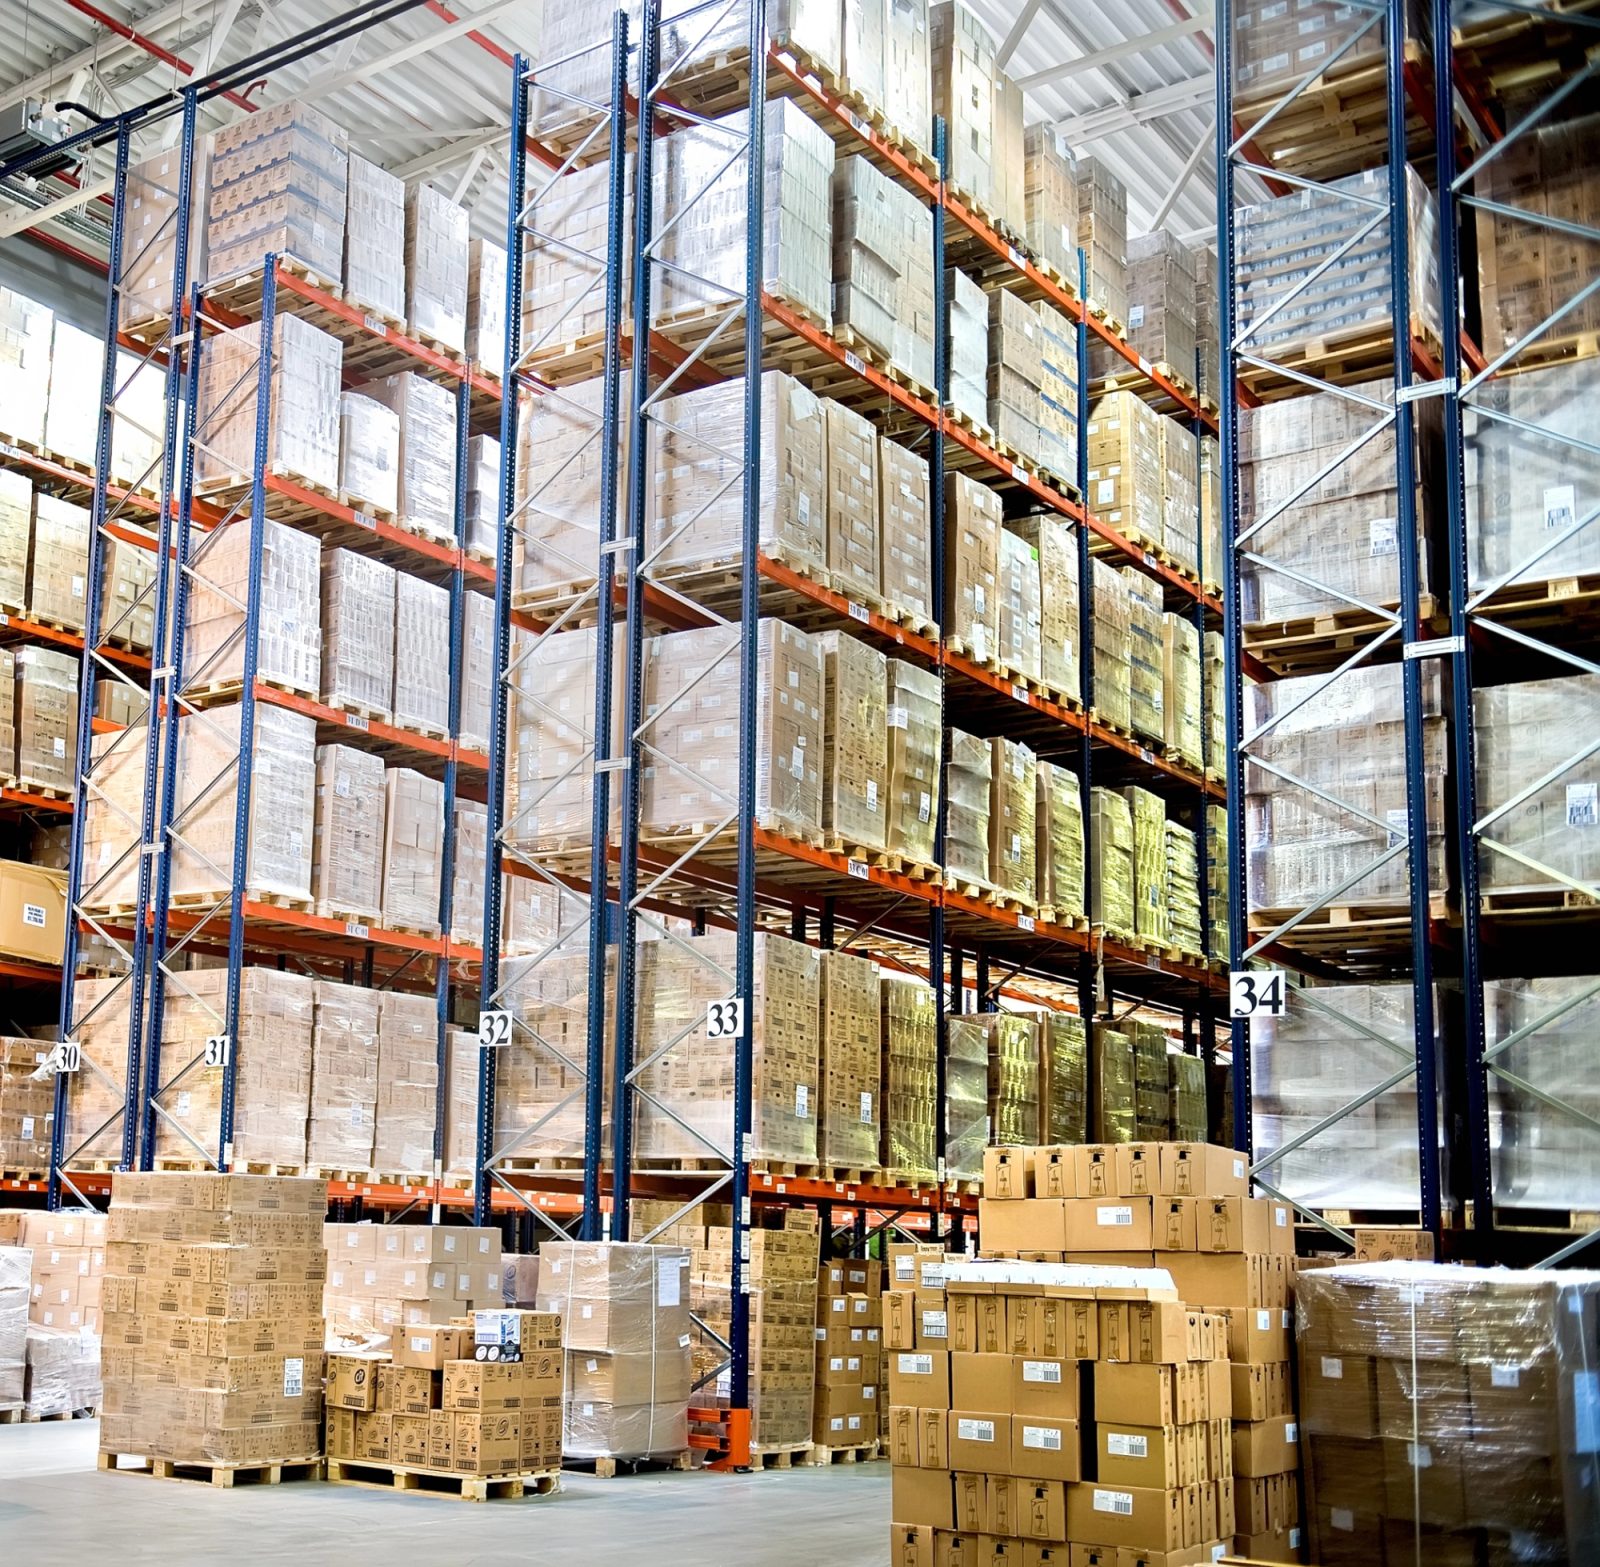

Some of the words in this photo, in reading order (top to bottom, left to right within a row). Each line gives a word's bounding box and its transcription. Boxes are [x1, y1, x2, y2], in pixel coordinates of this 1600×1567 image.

[1234, 975, 1283, 1016] 34
[480, 1014, 509, 1045] 32
[708, 1002, 738, 1037] 33
[56, 1045, 78, 1071] 30
[205, 1039, 226, 1066] 31
